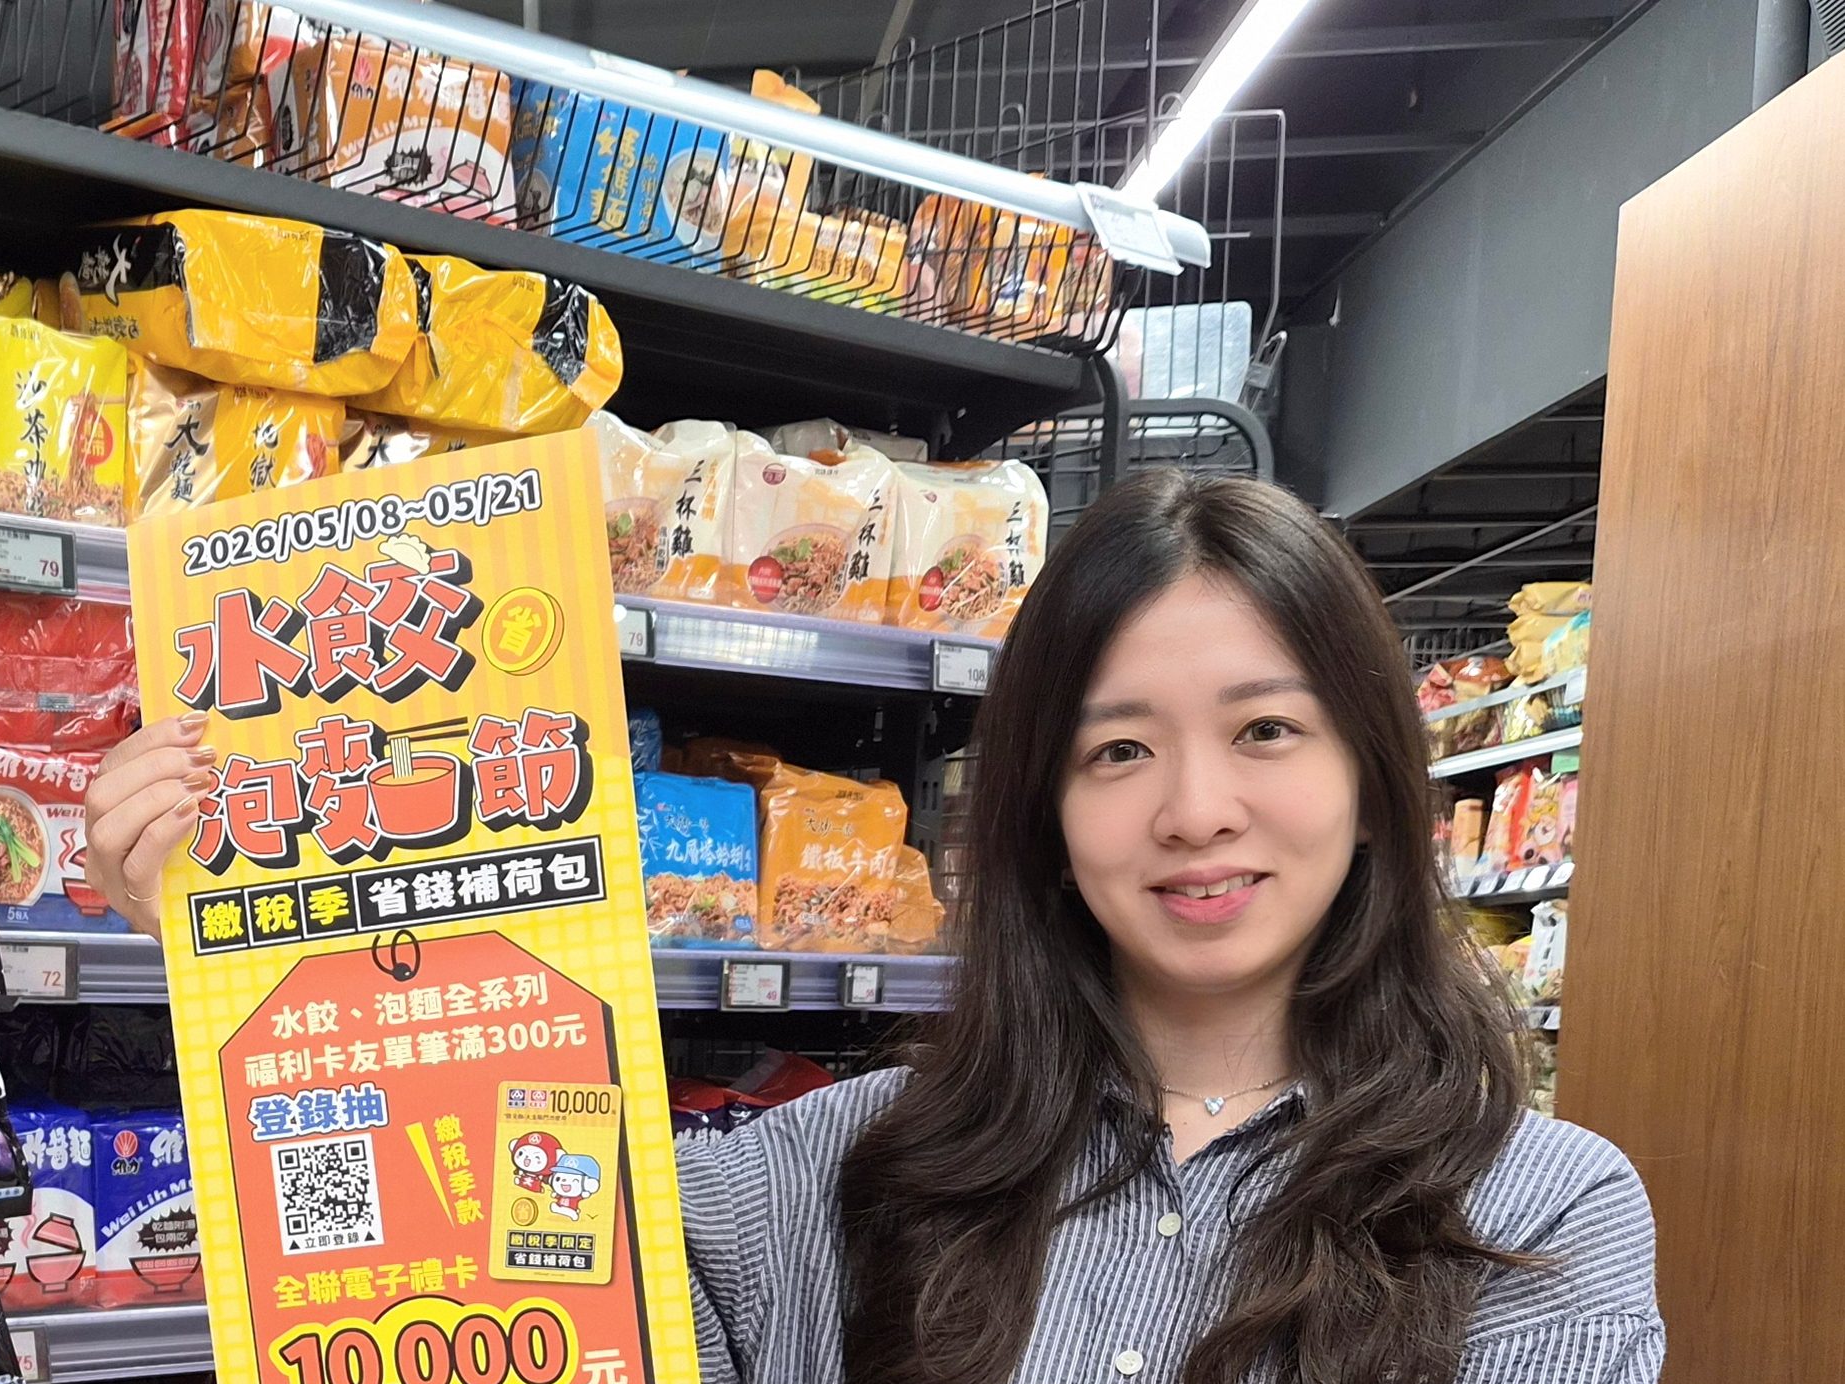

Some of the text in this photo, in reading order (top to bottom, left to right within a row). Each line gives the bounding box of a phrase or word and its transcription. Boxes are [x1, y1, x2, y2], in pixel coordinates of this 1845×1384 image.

[164, 415, 210, 502] 大乾麵
[186, 471, 542, 574] 2026/05/08~05/21
[671, 459, 706, 557] 三杯雞
[849, 488, 885, 581] 三杯雞
[39, 559, 61, 578] 79
[174, 549, 483, 718] 水餃
[500, 606, 541, 656] 省
[629, 632, 643, 646] 79
[201, 852, 591, 942] 繳稅季 省錢補荷包
[42, 971, 61, 986] 72
[272, 972, 549, 1039] 水餃、泡麵全系列
[244, 1014, 587, 1087] 福利卡友單筆滿300元
[251, 1082, 387, 1141] 登錄抽
[549, 1089, 611, 1115] 10,000
[432, 1113, 484, 1227] 繳稅季款
[304, 1232, 361, 1251] 立即登錄
[514, 1252, 586, 1268] 省錢補荷包
[273, 1255, 479, 1309] 全聯電子禮卡
